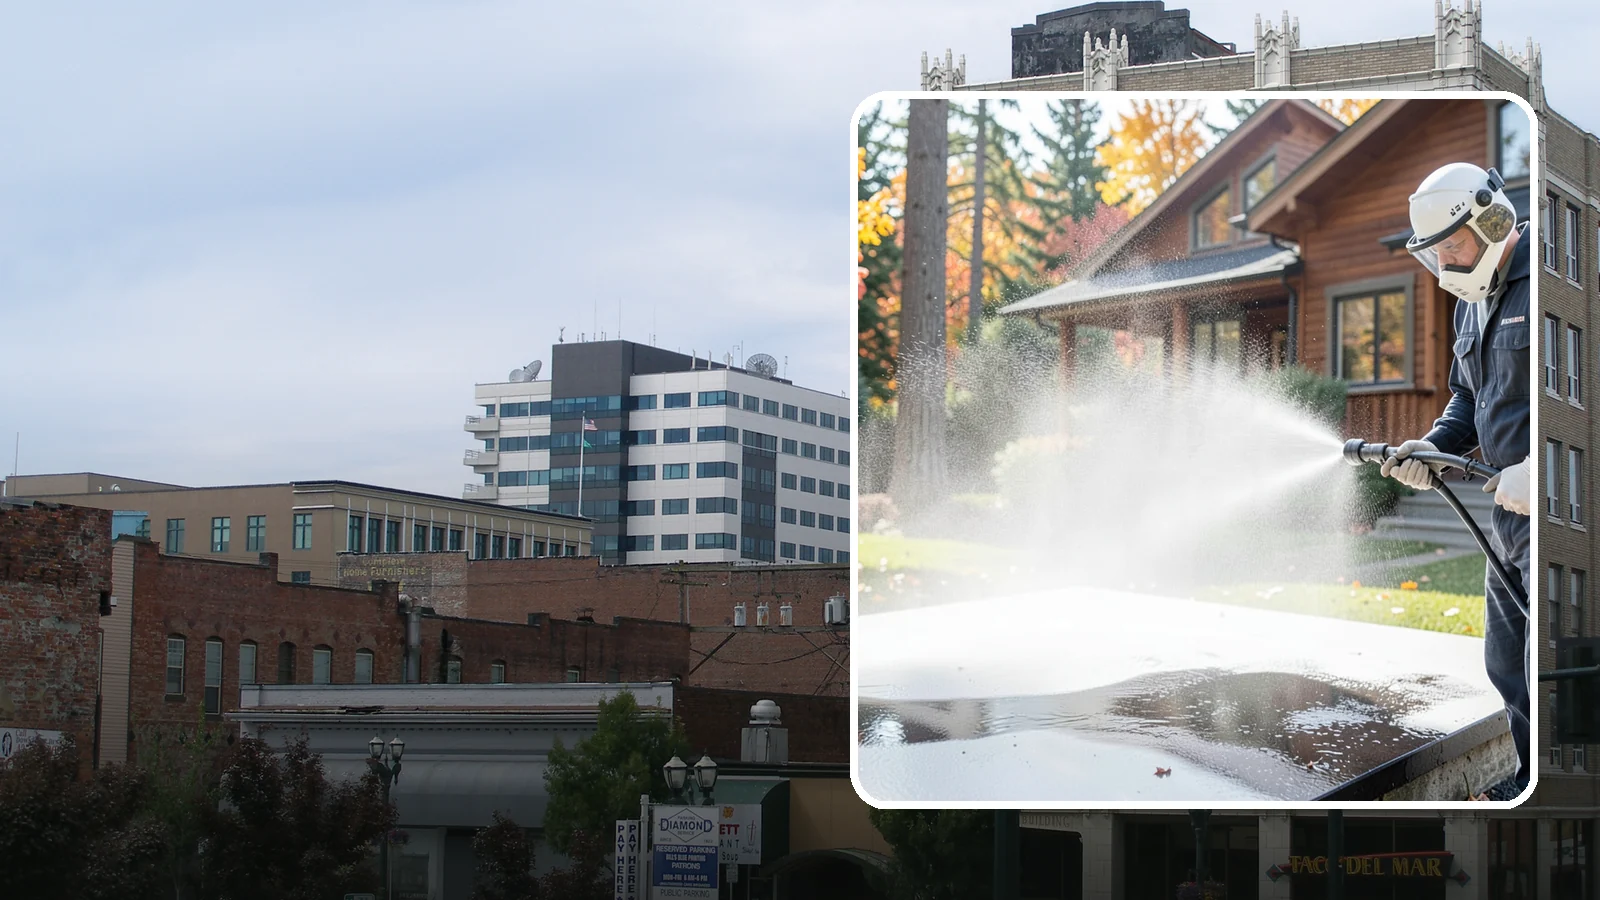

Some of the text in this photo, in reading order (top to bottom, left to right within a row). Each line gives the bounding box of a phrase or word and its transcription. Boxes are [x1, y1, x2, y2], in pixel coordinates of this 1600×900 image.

[370, 566, 427, 576] Furnishers
[660, 818, 713, 832] DIAMOND
[1022, 815, 1070, 828] BUILDING
[655, 845, 716, 854] RESERVED PARKING
[671, 862, 701, 870] PATRONS
[1346, 856, 1385, 876] DEL
[1392, 857, 1442, 877] MAR
[660, 889, 710, 898] PUBLIC PARKING
